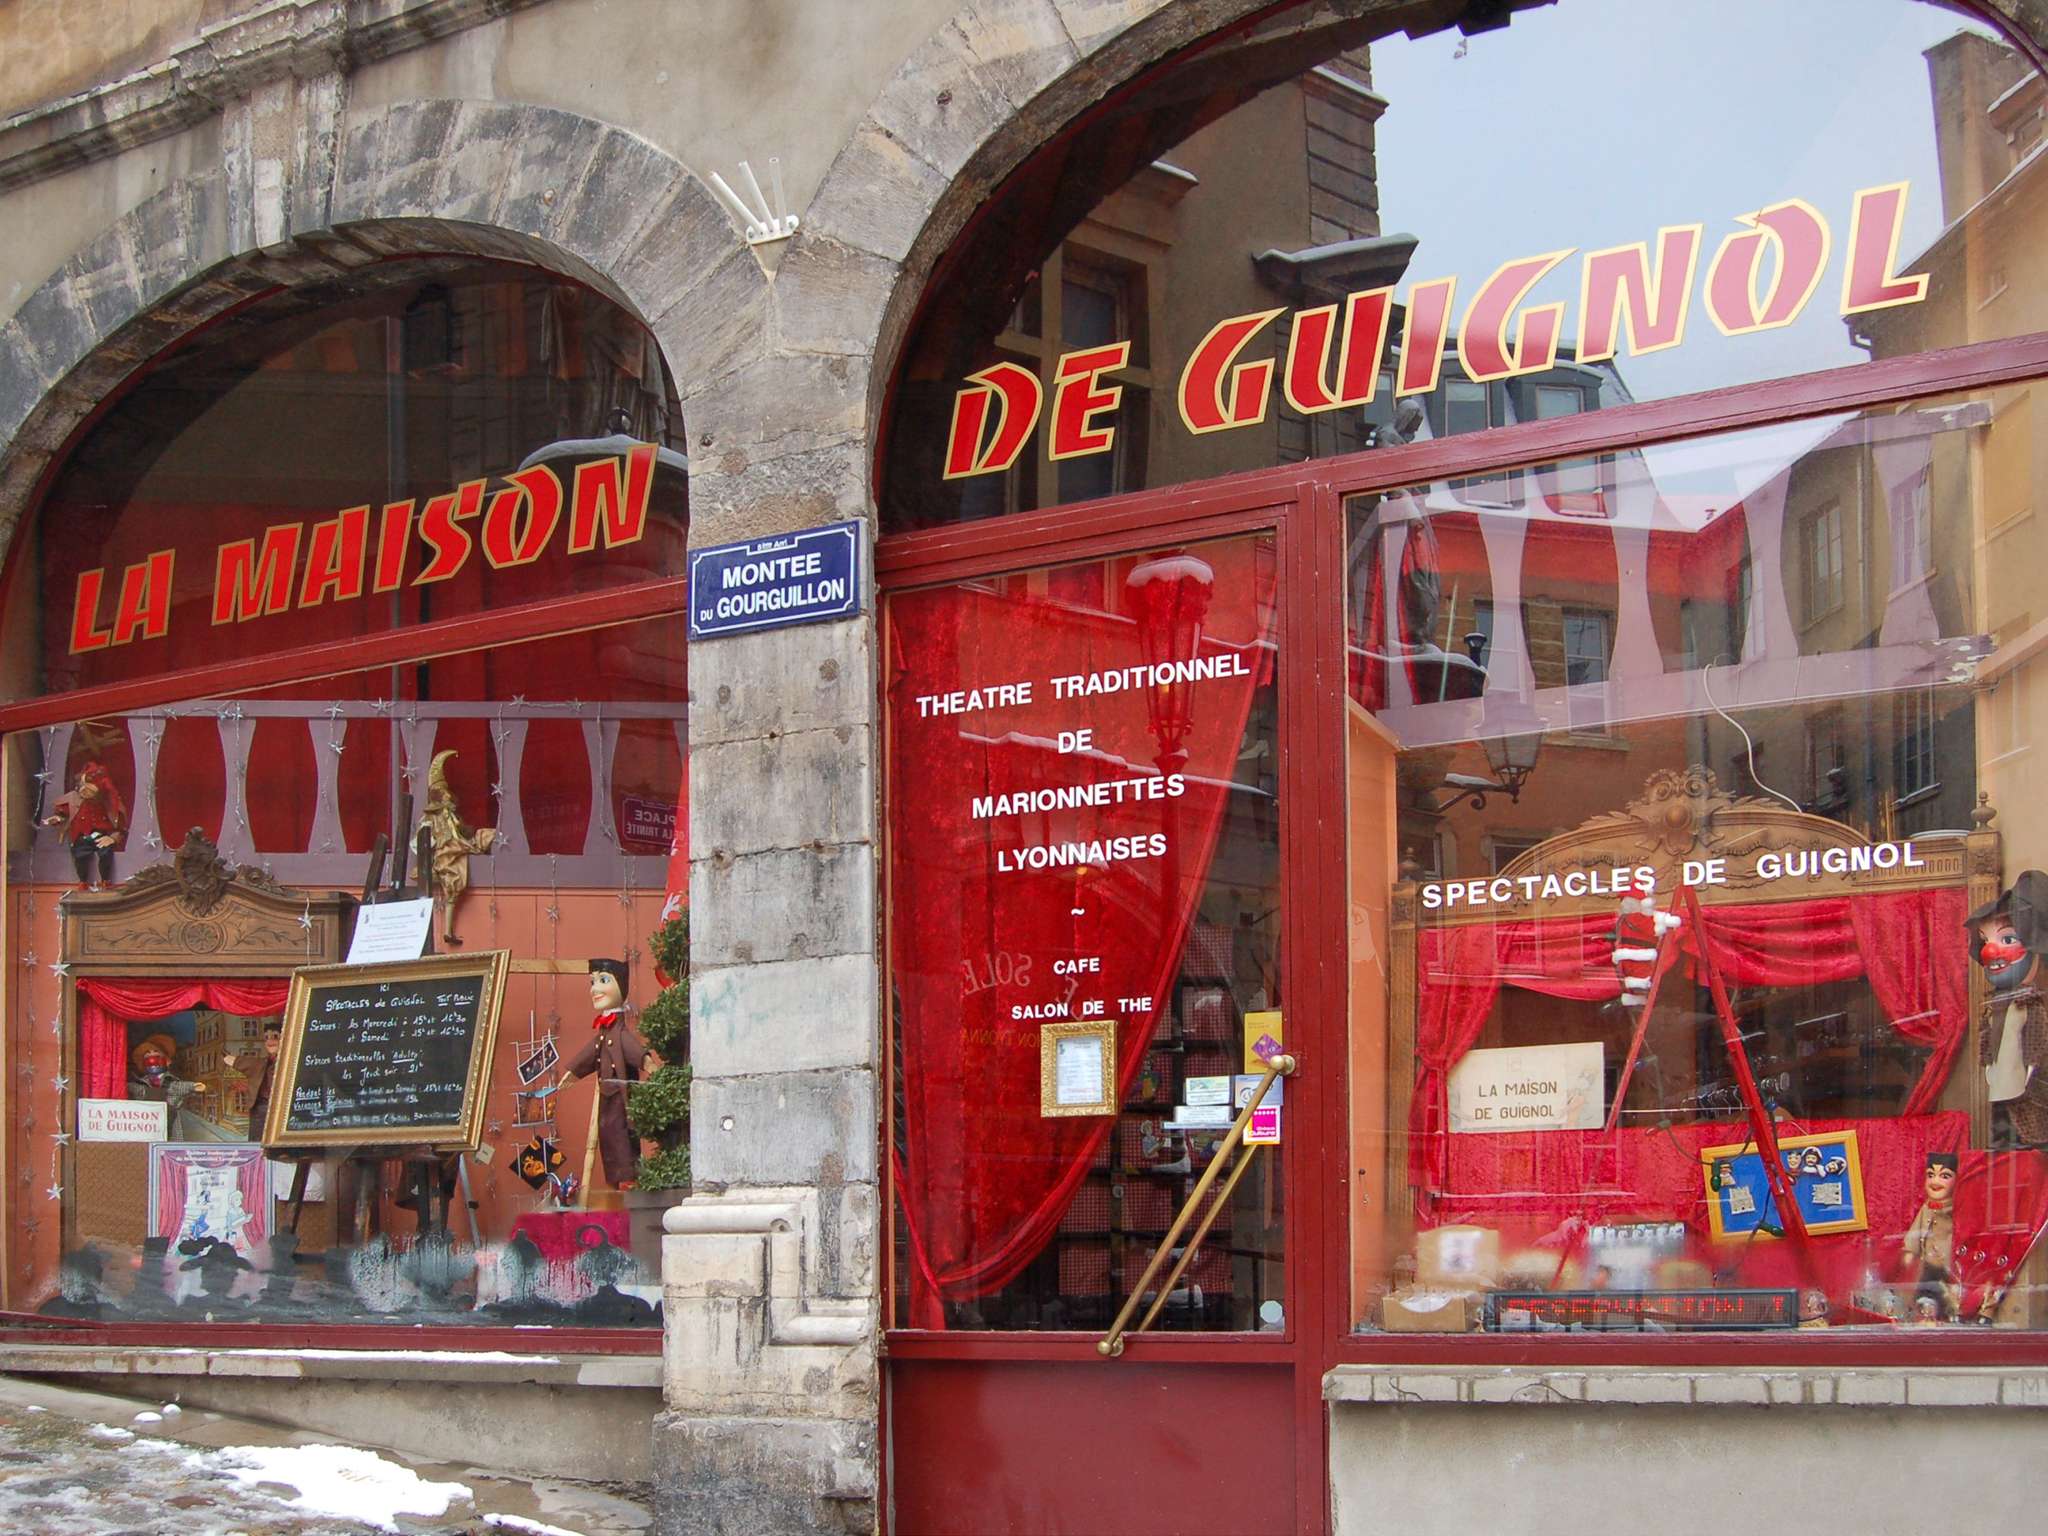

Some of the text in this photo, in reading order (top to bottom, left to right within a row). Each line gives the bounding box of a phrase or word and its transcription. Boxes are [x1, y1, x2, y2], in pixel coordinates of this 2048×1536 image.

[943, 181, 1930, 480] DE GUIGNOL
[68, 443, 659, 654] LA MAISON
[722, 552, 822, 589] MONTEE
[700, 578, 845, 622] DU GOURGUILLON
[915, 653, 1250, 718] THEATRE TRADITIONNEL
[1057, 729, 1093, 754] DE
[972, 774, 1186, 819] MARIONNETTES
[997, 833, 1167, 873] LYONNAISES
[1422, 841, 1925, 909] SPECTACLES DE GUIGNOL
[1053, 957, 1100, 975] CAFE
[1011, 997, 1152, 1020] SALON DE THE
[1478, 1078, 1558, 1098] LA MAISON
[88, 1110, 160, 1120] LA MAISON
[88, 1121, 102, 1131] DE
[1475, 1103, 1554, 1120] DE GUIGNOL
